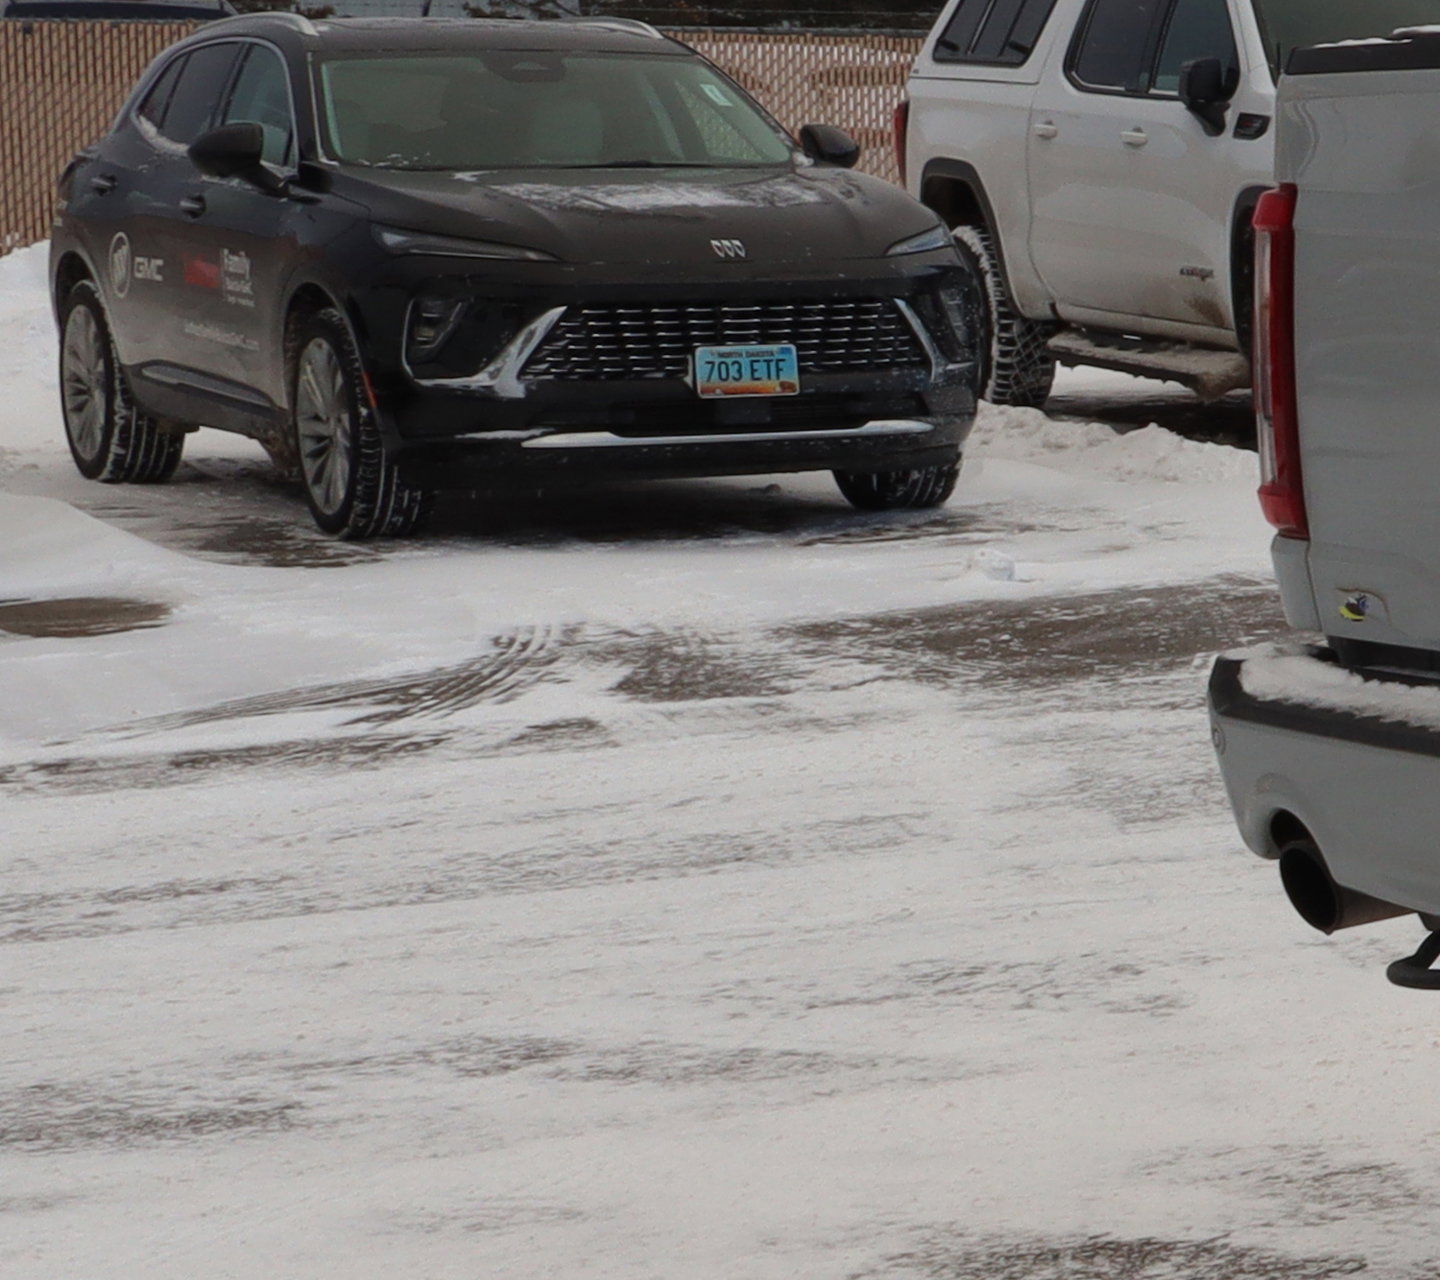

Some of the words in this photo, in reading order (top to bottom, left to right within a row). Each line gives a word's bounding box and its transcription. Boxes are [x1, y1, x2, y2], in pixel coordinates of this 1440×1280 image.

[133, 256, 164, 282] GMC
[704, 361, 743, 382] 703
[750, 358, 786, 381] ETF
